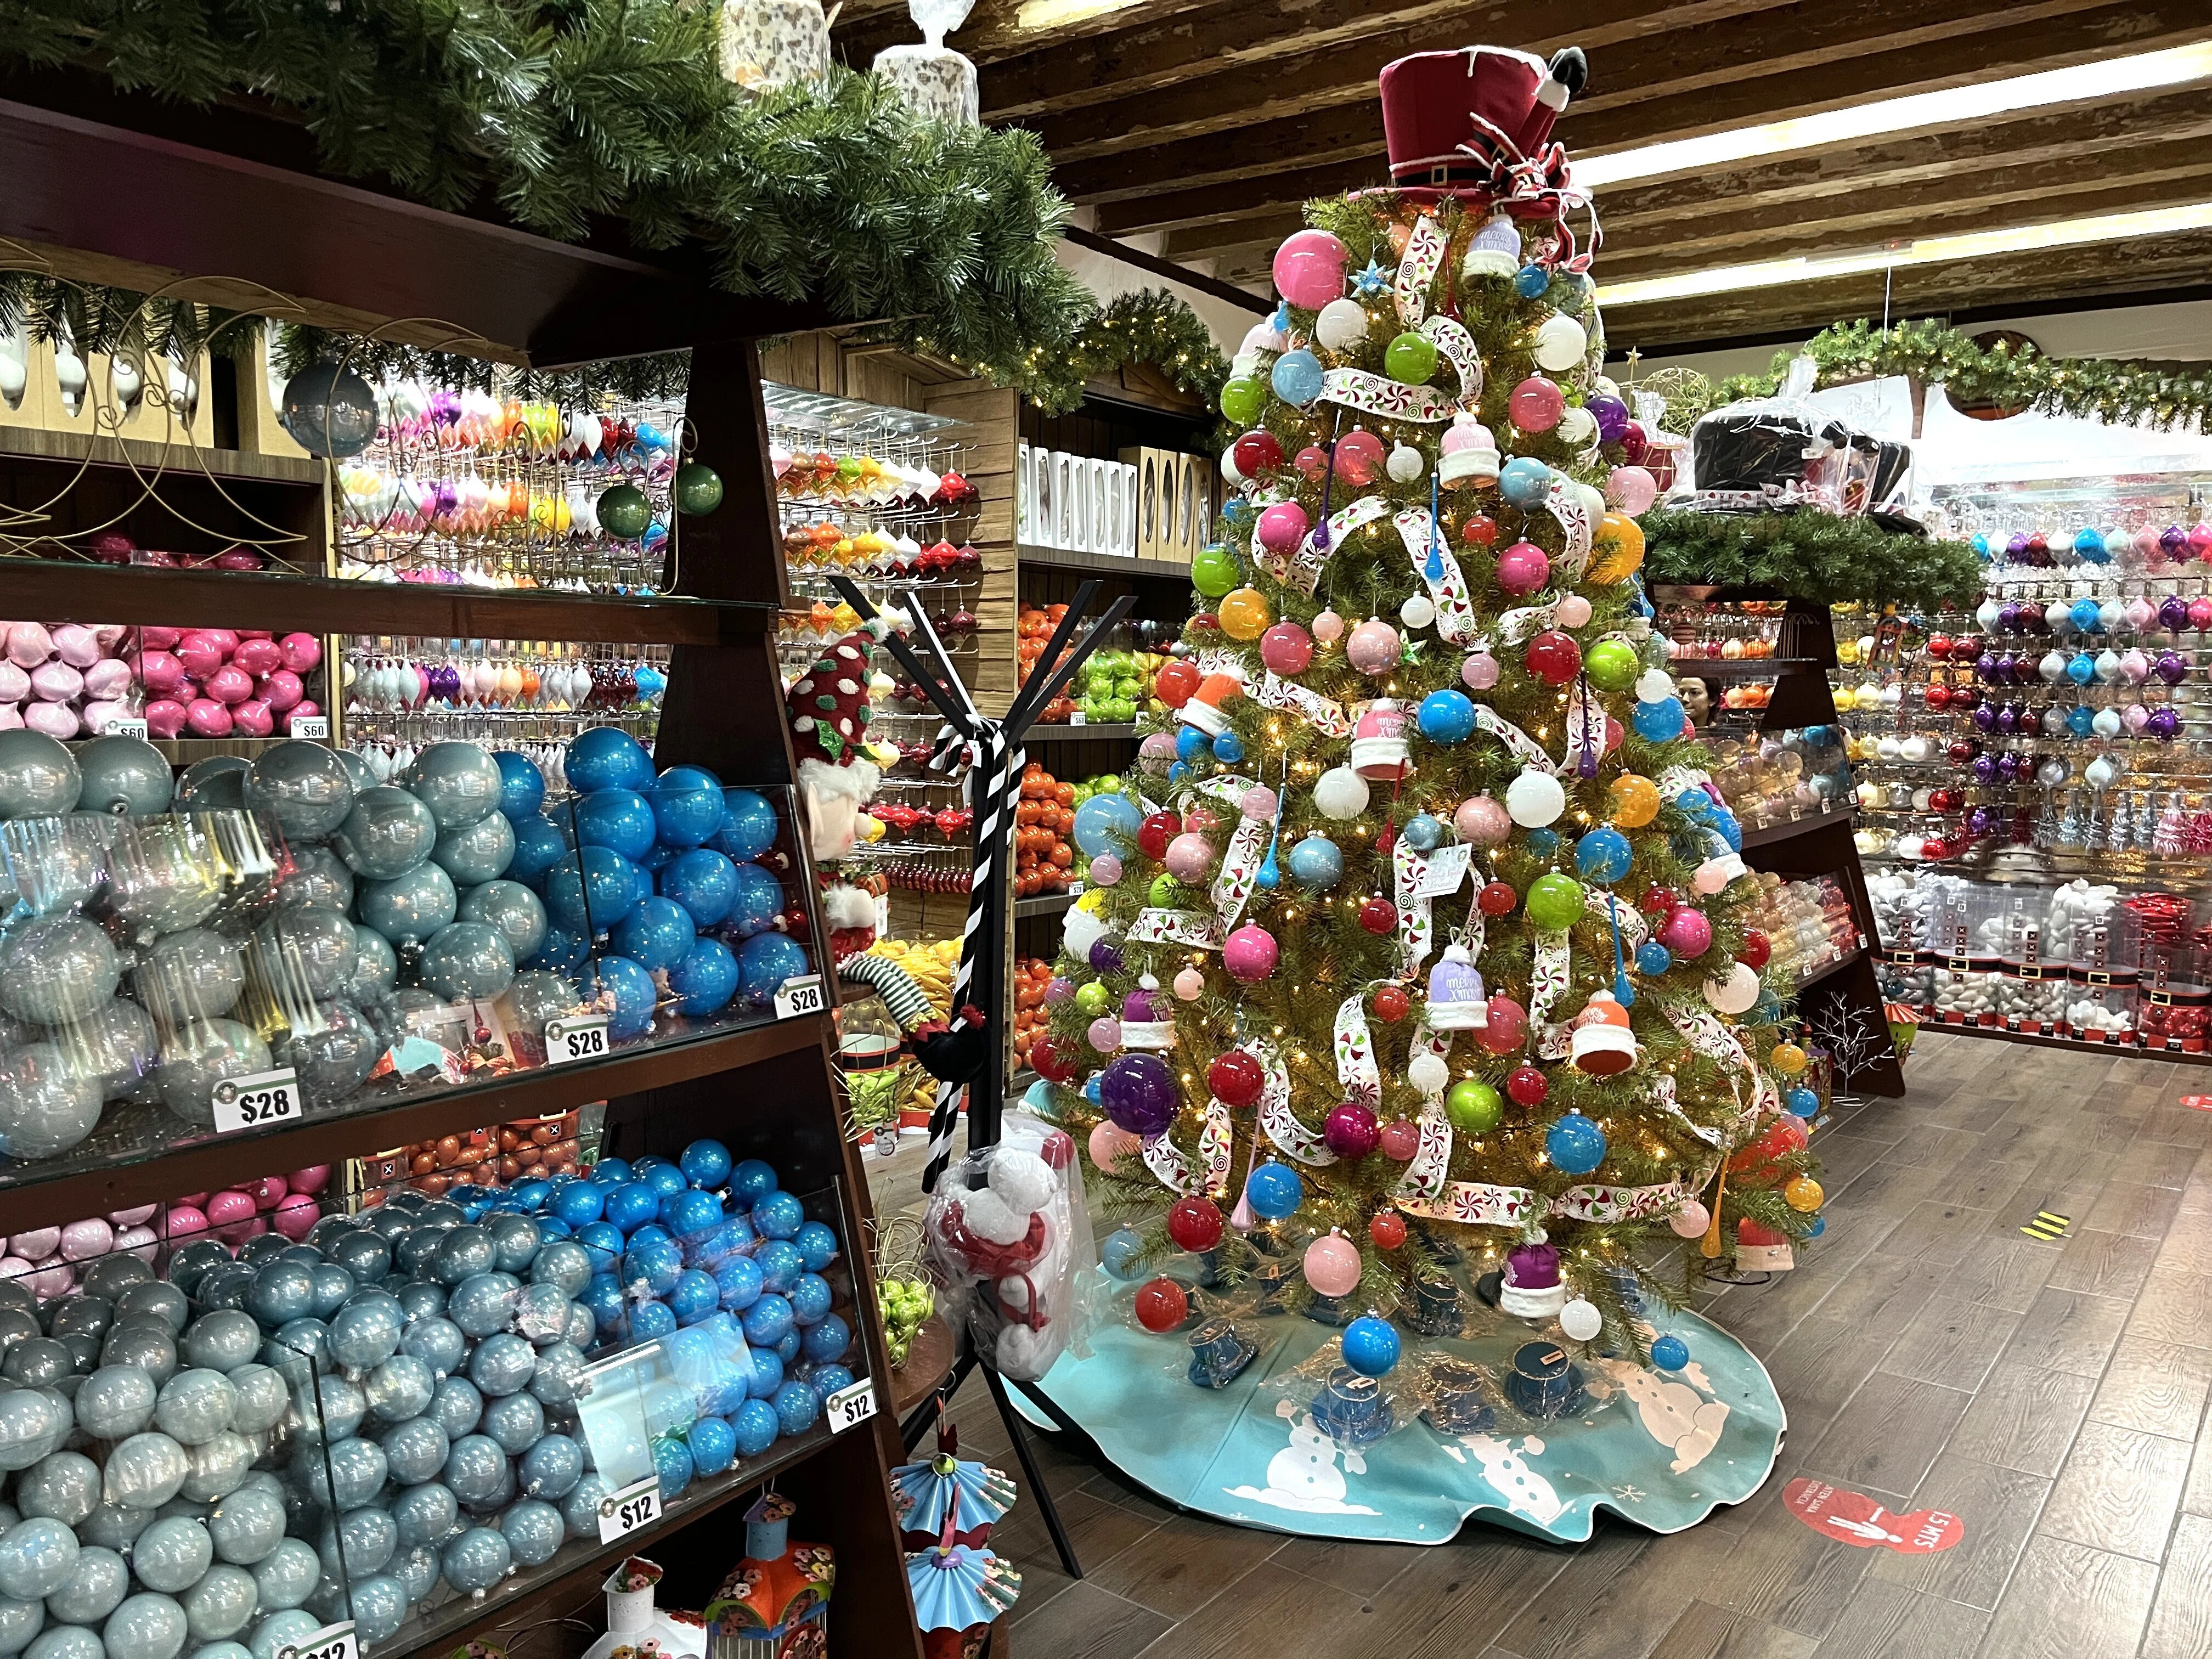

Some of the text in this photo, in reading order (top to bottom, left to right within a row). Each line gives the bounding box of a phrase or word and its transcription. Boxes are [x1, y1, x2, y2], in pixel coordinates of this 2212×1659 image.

[121, 727, 144, 739] $60
[304, 725, 324, 737] $60
[791, 988, 819, 1013] $28
[567, 1030, 603, 1058] $28
[239, 1089, 290, 1124] $28
[845, 1395, 870, 1423] $12
[620, 1496, 653, 1531] $12
[1913, 1511, 1952, 1549] 1.5 MTS
